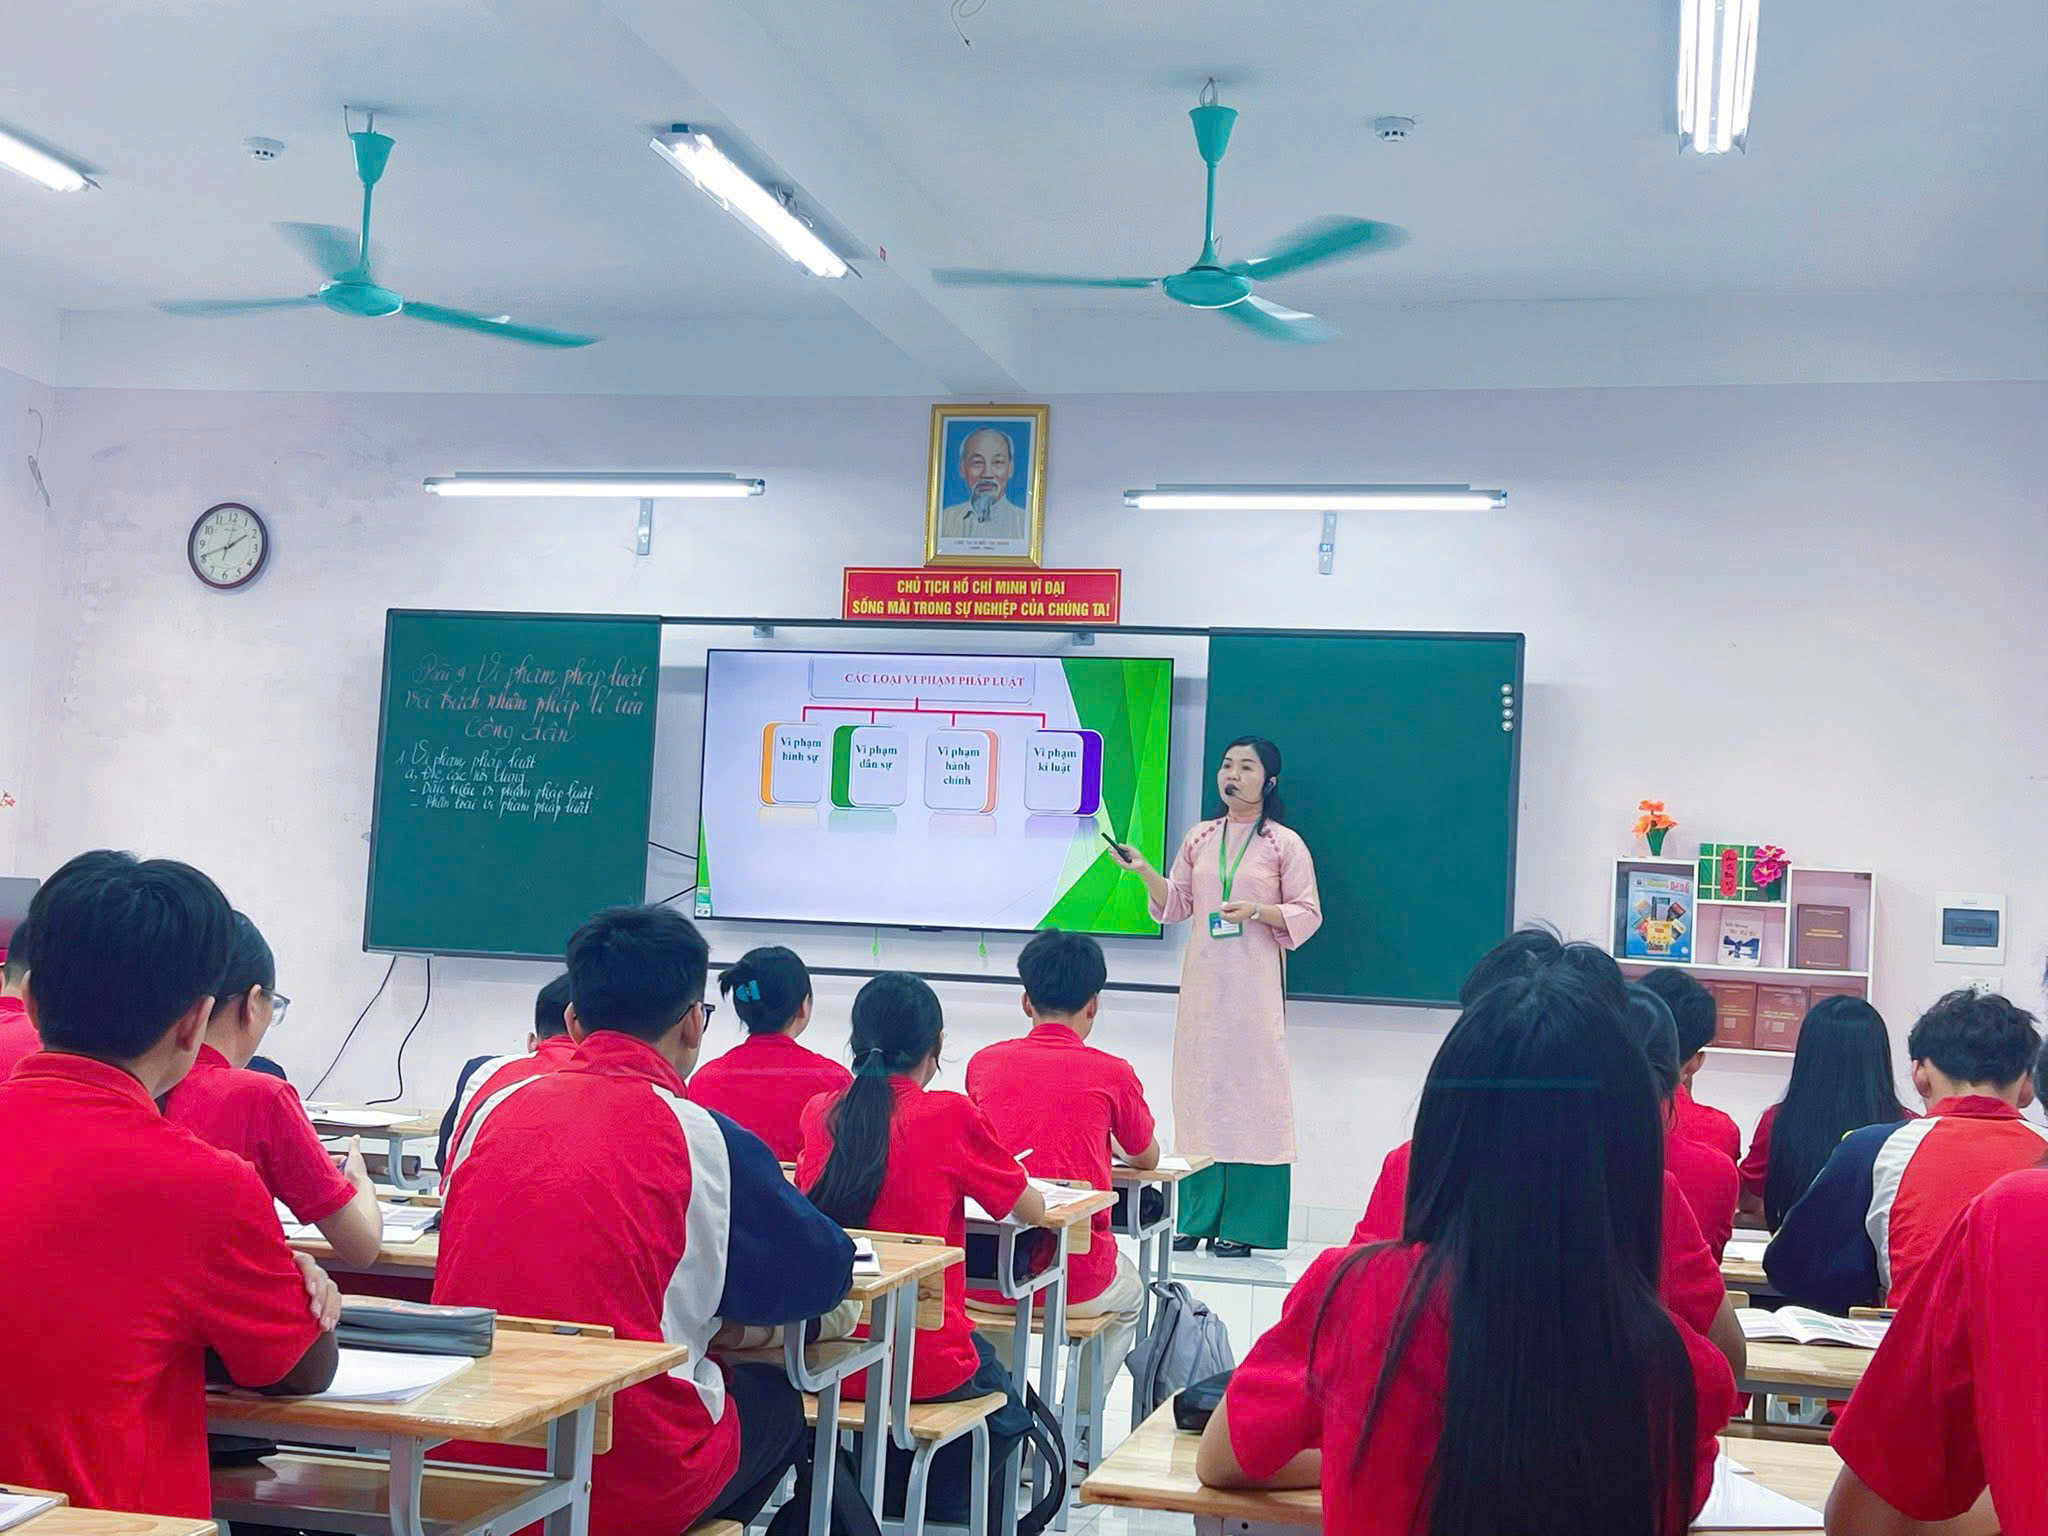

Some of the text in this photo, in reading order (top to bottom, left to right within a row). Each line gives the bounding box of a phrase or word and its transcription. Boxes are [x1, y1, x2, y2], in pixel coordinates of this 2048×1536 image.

[215, 514, 223, 525] 11
[229, 512, 239, 523] 12
[244, 517, 248, 527] 1
[204, 525, 214, 535] 10
[251, 528, 257, 539] 2
[199, 539, 206, 549] 9
[252, 543, 258, 553] 3
[246, 558, 253, 567] 4
[209, 565, 215, 576] 7
[221, 571, 228, 580] 6
[235, 567, 242, 577] 5
[897, 575, 921, 594] CHỦ
[924, 580, 950, 597] TỊCH
[972, 577, 993, 594] CHÍ
[995, 580, 1027, 595] MINH
[1030, 577, 1042, 595] VĨ
[1045, 580, 1065, 598] ĐẠI
[852, 595, 885, 614] SỐNG
[913, 601, 952, 615] TRONG
[955, 600, 973, 618] SỰ
[974, 599, 1018, 618] NGHIỆP
[1021, 598, 1045, 616] CỦA
[1048, 600, 1089, 616] CHÚNG
[844, 672, 1025, 689] CÁC LOẠI VI PHẠM PHÁP LUẬT
[793, 738, 822, 750] phạm
[869, 745, 898, 757] phạm
[951, 747, 980, 759] phạm
[1047, 747, 1077, 760] phạm
[806, 753, 819, 764] sự
[859, 758, 893, 771] dân sự
[1051, 762, 1071, 774] luật
